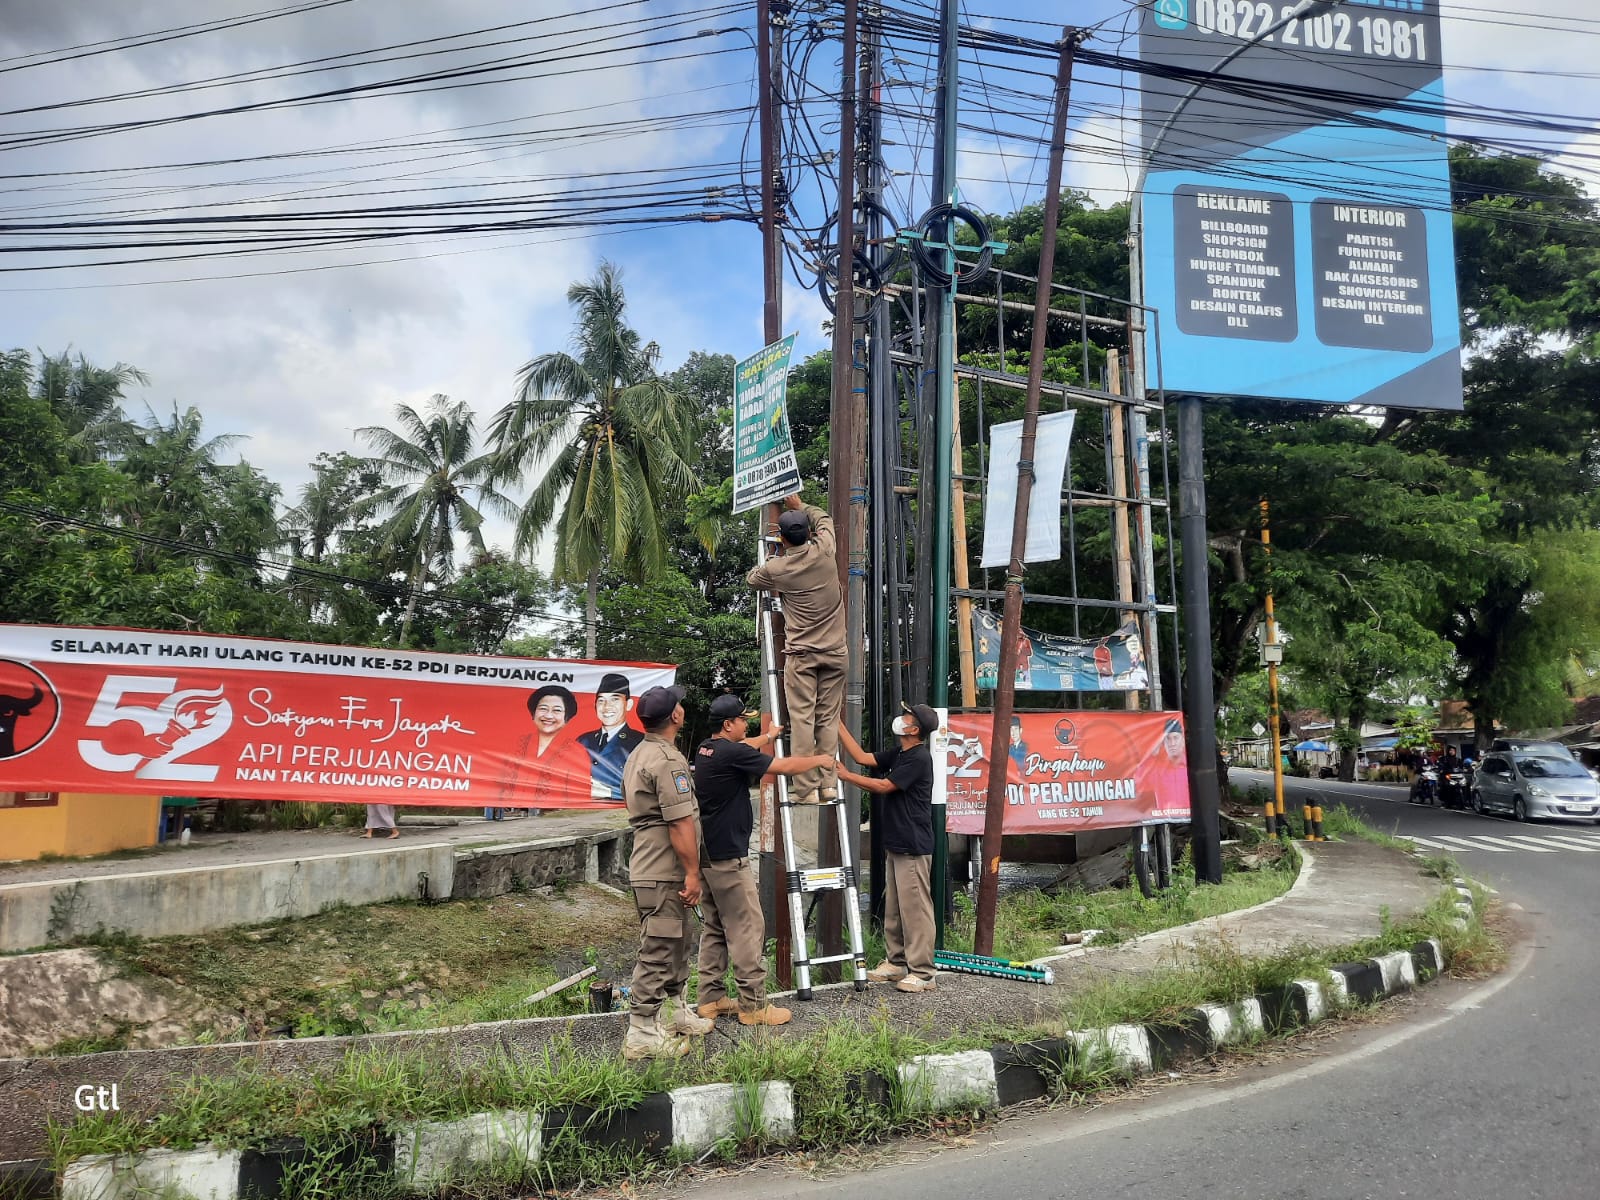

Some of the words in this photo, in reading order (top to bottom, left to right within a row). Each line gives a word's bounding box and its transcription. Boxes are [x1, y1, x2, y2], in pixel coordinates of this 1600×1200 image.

[1195, 0, 1274, 42] 0822
[1281, 5, 1352, 51] 2102
[1358, 16, 1426, 61] 1981
[1197, 193, 1271, 214] REKLAME
[1333, 206, 1406, 227] INTERIOR
[1200, 220, 1268, 235] BILLBOARD
[1203, 234, 1267, 248] SHOPSIGN
[1346, 233, 1394, 247] PARTISI
[1206, 247, 1264, 262] NEONBOX
[1338, 246, 1404, 261] FURNITURE
[1190, 259, 1232, 272] HURUF
[1234, 262, 1280, 277] TIMBUL
[1348, 260, 1394, 273] ALMARI
[1206, 274, 1266, 289] SPANDUK
[1325, 271, 1350, 282] RAK
[1351, 273, 1418, 289] AKSESORIS
[1212, 288, 1261, 302] RONTEK
[1338, 285, 1407, 300] SHOWCASE
[1190, 300, 1236, 313] DESAIN
[1239, 303, 1283, 317] GRAFIS
[1322, 297, 1366, 311] DESAIN
[1368, 301, 1424, 315] INTERIOR
[1227, 316, 1248, 328] DLL
[1363, 313, 1385, 325] DLL
[51, 639, 152, 656] SELAMAT
[158, 643, 209, 659] HARI
[215, 646, 283, 662] ULANG
[289, 651, 356, 667] TAHUN
[361, 656, 413, 672] KE-52
[417, 660, 450, 674] PDI
[456, 664, 575, 683] PERJUANGAN
[243, 687, 335, 737] Satyam
[370, 698, 477, 748] Jayate
[77, 674, 233, 782] 52
[238, 742, 283, 764] API
[291, 745, 473, 775] PERJUANGAN
[1025, 752, 1106, 778] Dirgahayu
[235, 767, 276, 782] NAN
[281, 769, 316, 784] TAK
[318, 771, 405, 788] KUNJUNG
[407, 775, 471, 791] PADAM
[1004, 783, 1026, 806] DI
[1029, 779, 1136, 805] PERJUANGAN
[1038, 808, 1057, 819] YANG
[1058, 807, 1069, 818] KE
[1069, 807, 1080, 818] 52
[1082, 806, 1103, 818] TAHUN
